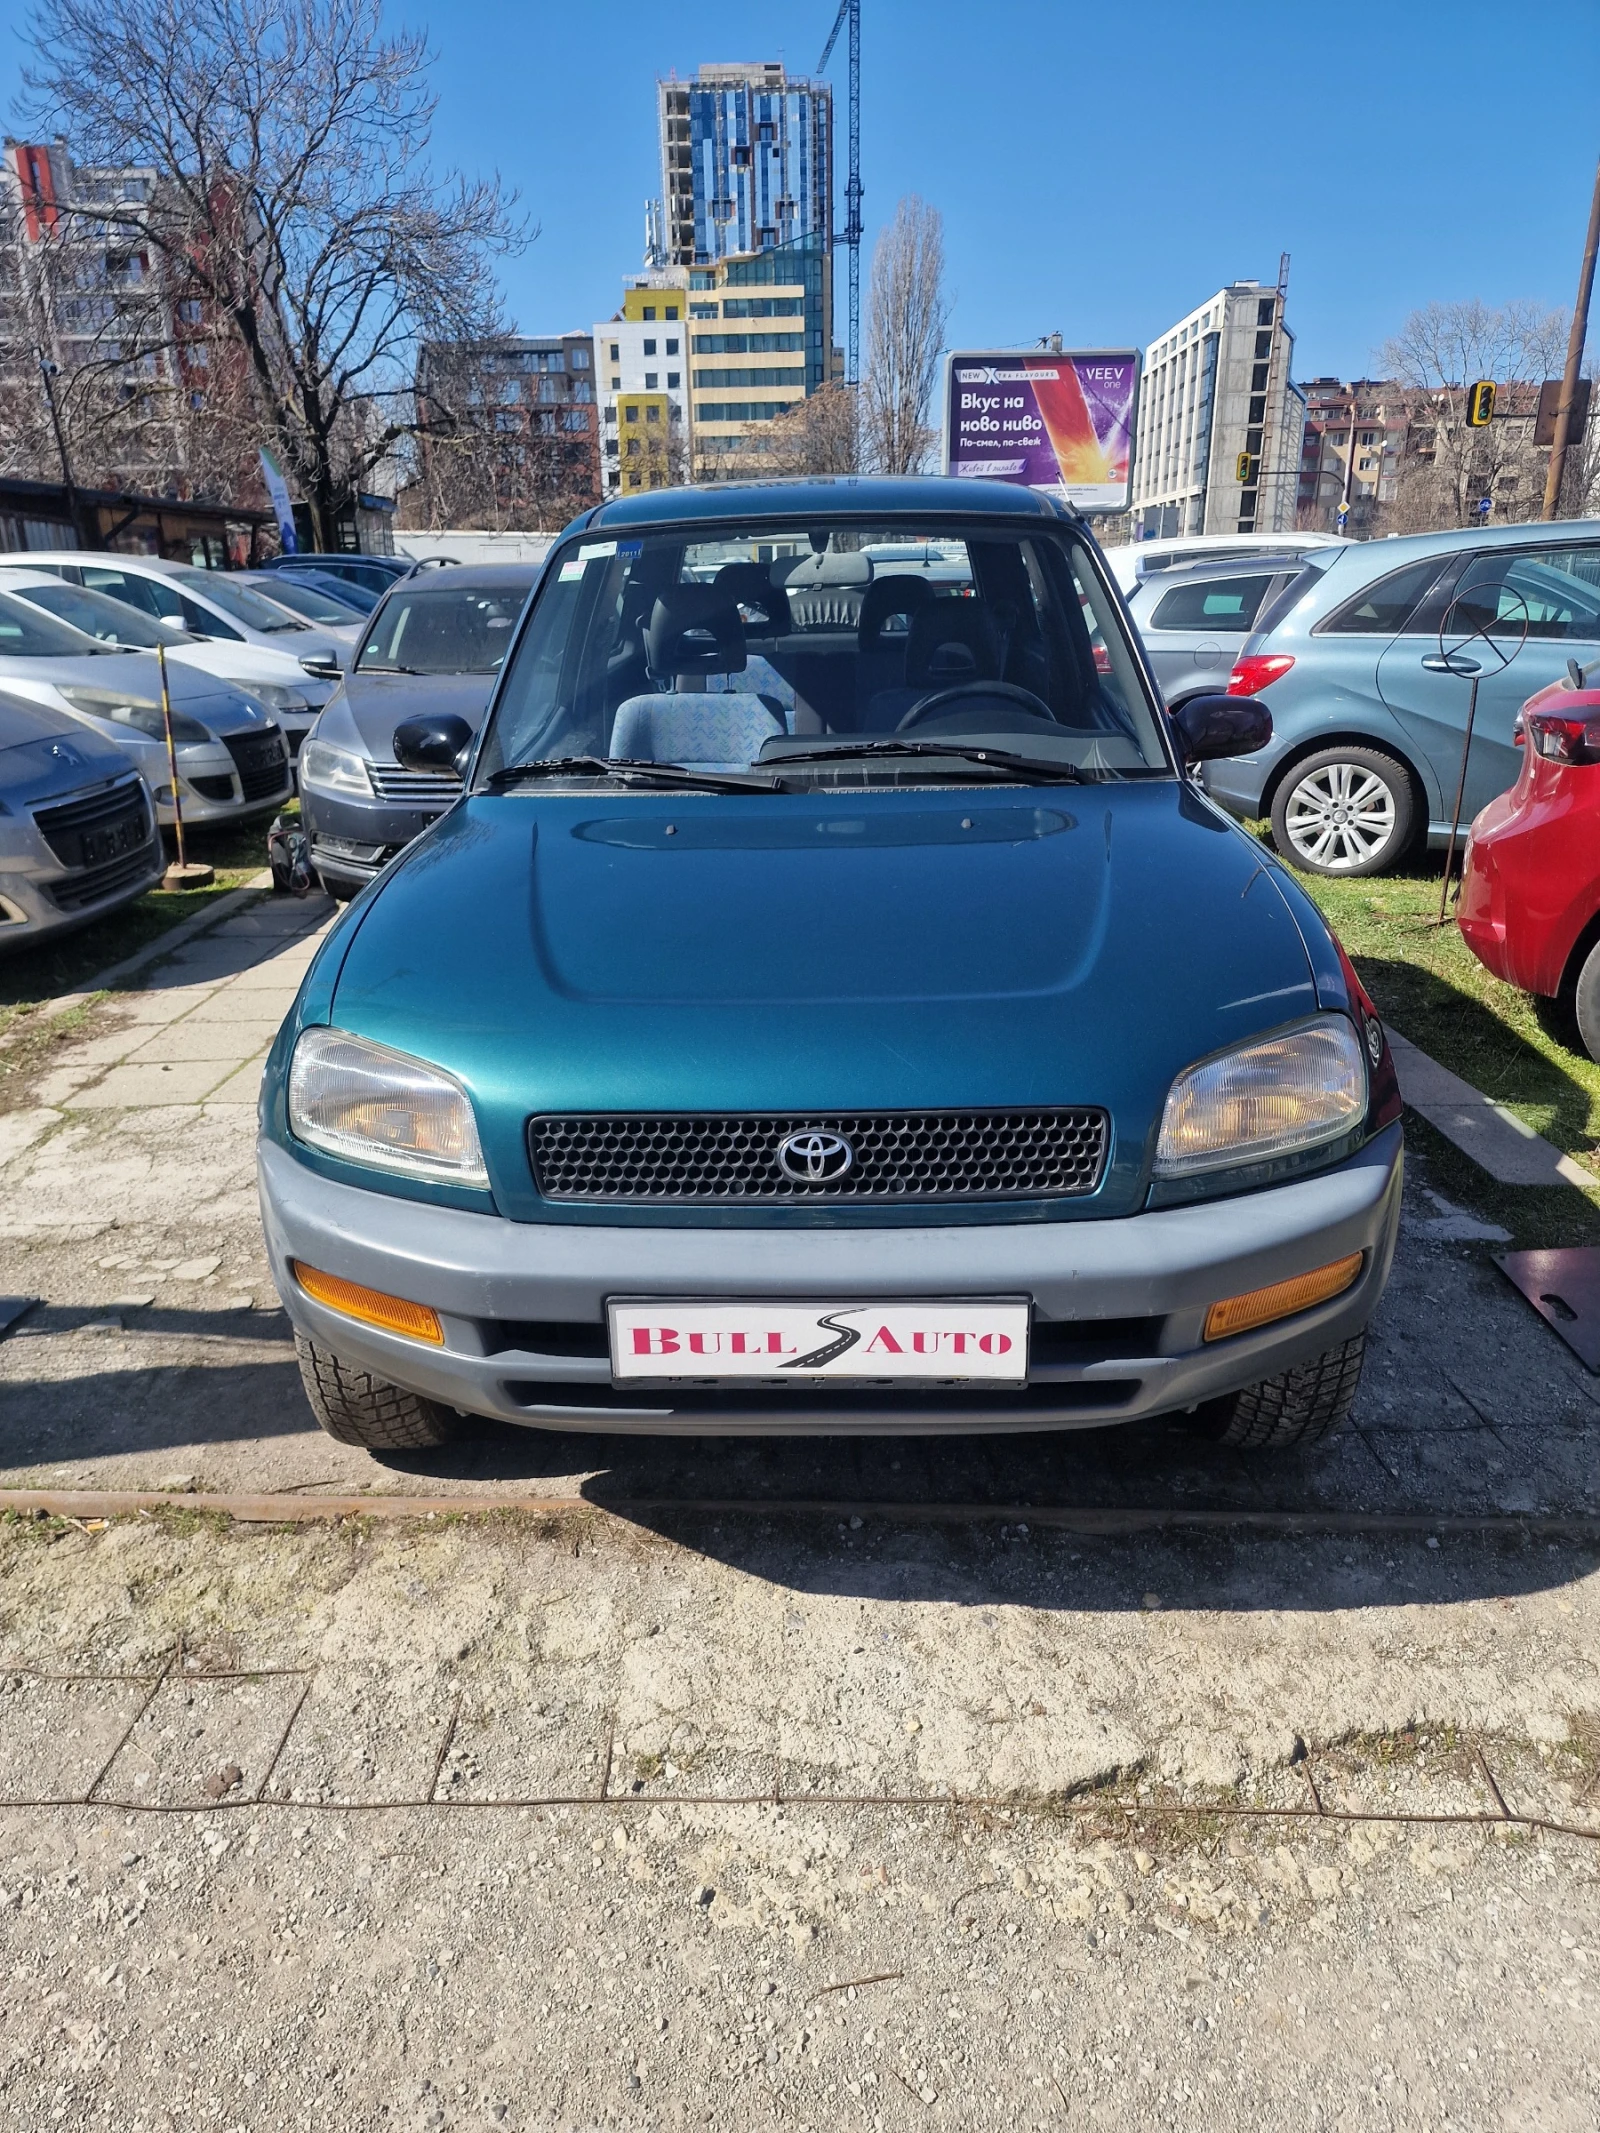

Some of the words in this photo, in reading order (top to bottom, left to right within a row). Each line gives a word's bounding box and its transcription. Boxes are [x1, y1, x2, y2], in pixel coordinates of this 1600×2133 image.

[961, 372, 981, 380] NEW
[1015, 371, 1055, 379] FLAVOURS
[1086, 367, 1125, 380] VEEV
[1103, 381, 1121, 389] one
[961, 393, 1000, 412] Вкус
[1003, 397, 1024, 409] на
[960, 415, 1000, 432] ново
[1002, 414, 1042, 431] ниво
[960, 437, 1002, 448] По-смел,
[1002, 436, 1042, 447] по-свеж
[627, 1327, 798, 1356] BULL
[861, 1325, 1013, 1355] AUTO
